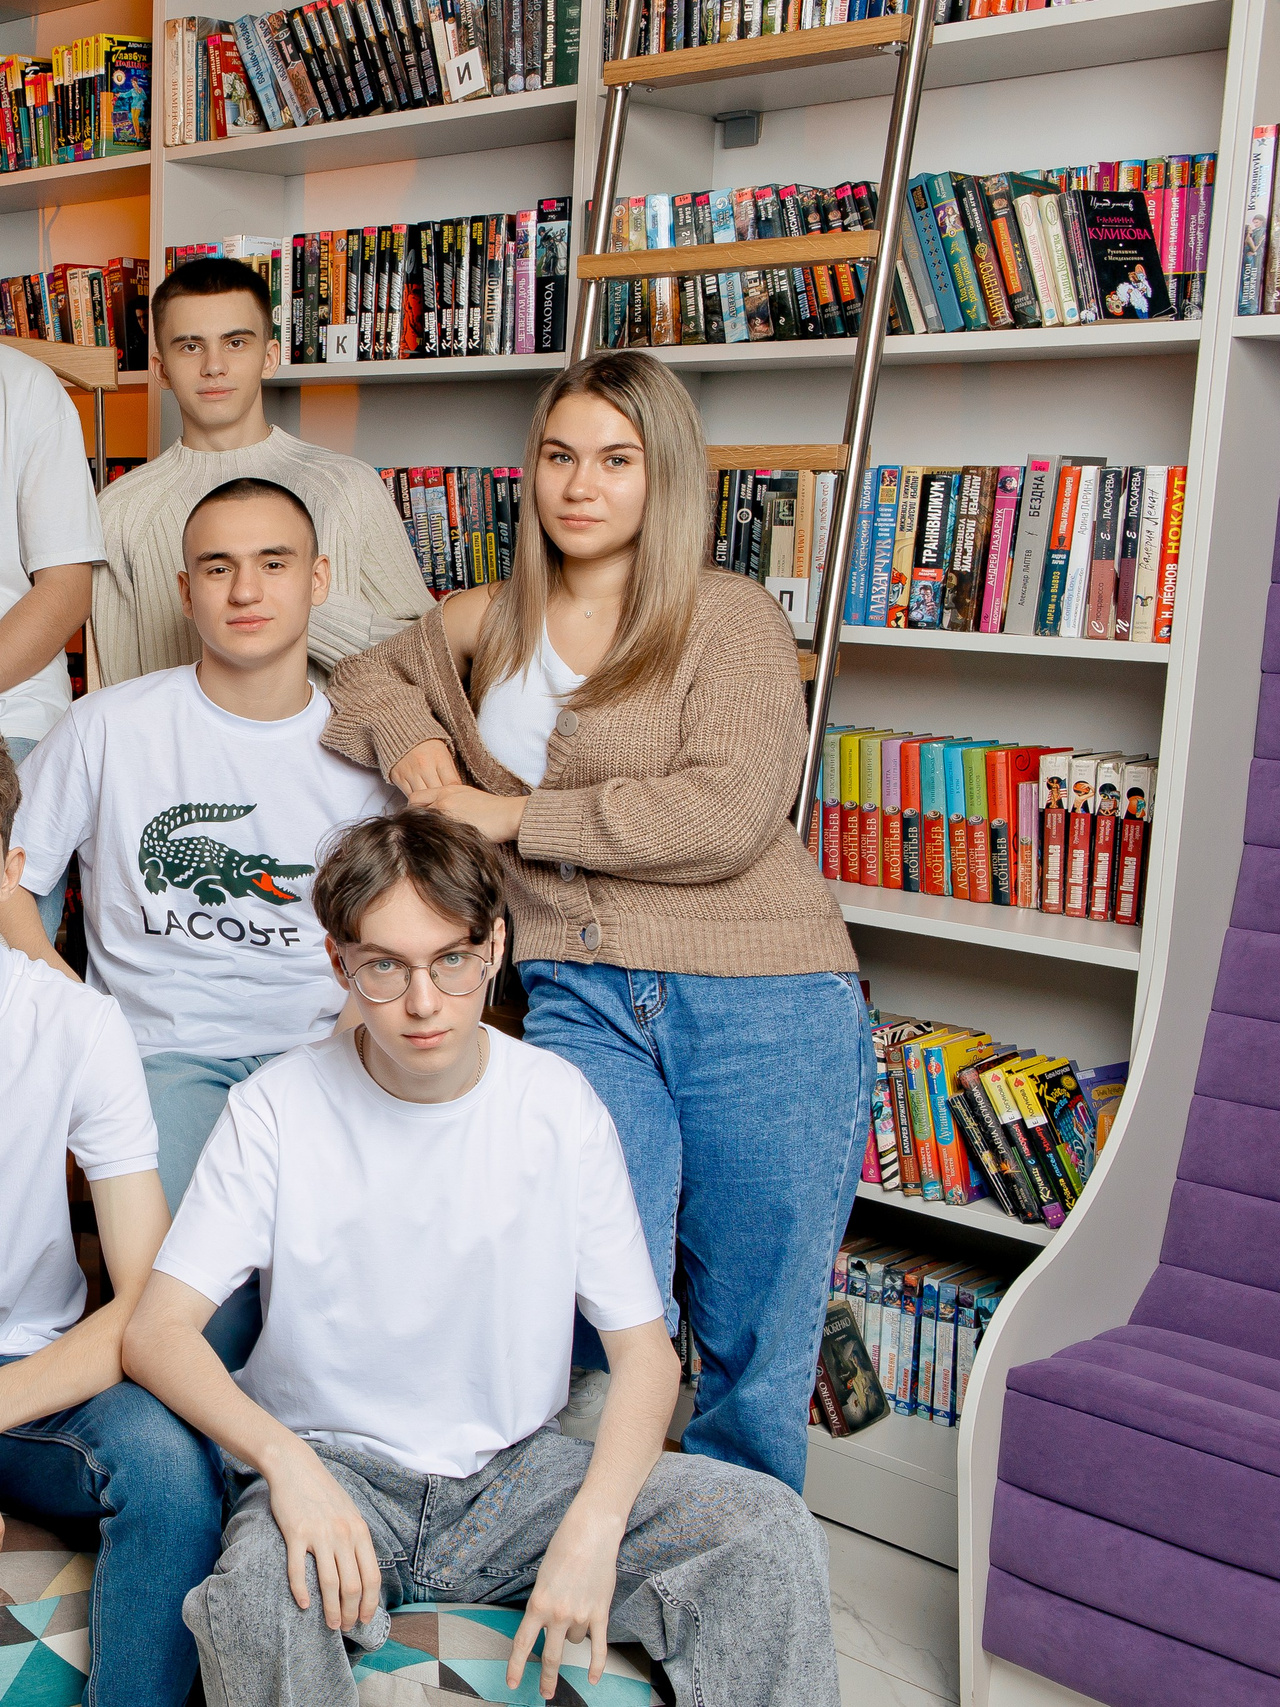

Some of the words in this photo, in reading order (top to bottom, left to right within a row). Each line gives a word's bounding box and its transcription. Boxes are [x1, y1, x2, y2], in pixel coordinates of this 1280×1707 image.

[238, 22, 258, 49] ГНЕЗДО
[544, 24, 555, 59] Черного
[112, 46, 146, 62] Главбух
[249, 50, 266, 85] БОЛЬШОЕ
[456, 61, 472, 86] И
[544, 61, 554, 85] Тайна
[967, 189, 977, 207] АГЕНТ
[1147, 199, 1156, 220] ТЕЛО
[972, 207, 983, 232] ОСОБЫЙ
[1088, 227, 1152, 240] КУЛИКОВА
[1168, 197, 1180, 243] НАМЕРЕНИЯ
[1167, 245, 1177, 269] НАГИЕ
[347, 272, 357, 311] ОБОРОТНИ
[363, 272, 372, 309] ОБОРОТНИ
[423, 268, 434, 308] ОБОРОТНИ
[518, 278, 526, 298] ДОЧЬ
[683, 280, 695, 317] НИЖНИЙ
[726, 279, 733, 290] ВО
[806, 285, 817, 317] АНДРЕЯ
[819, 276, 828, 298] УБИТЬ
[841, 274, 851, 296] УБИТЬ
[978, 261, 1006, 318] АНТИТЕРРОР
[518, 299, 526, 342] ЧЕТВЕРТАЯ
[542, 282, 555, 348] КУКЛОВОД
[727, 291, 737, 318] ДВЕРИ
[336, 335, 347, 354] К
[468, 307, 481, 349] КАЗАНЦЕВ
[961, 474, 971, 515] МИХАИЛ
[970, 475, 981, 515] АНДРЕЙ
[1029, 475, 1045, 517] БЕЗДНА
[1080, 478, 1094, 511] ЛАРИНА
[1102, 472, 1116, 519] ЛАСКАРЕВА
[1128, 471, 1141, 518] ЛАСКАРЕВА
[1143, 488, 1159, 526] Леман
[922, 481, 945, 564] ТРАНКВИЛИУМ
[991, 508, 1003, 551] ЛАЗАРЧУК
[1077, 512, 1089, 535] Арина
[1167, 476, 1186, 554] НОКАУТ
[451, 528, 460, 541] 12
[498, 522, 509, 544] БОЙ
[859, 519, 870, 572] УСПЕНСКИЙ
[953, 518, 965, 571] УСПЕНСКИЙ
[961, 519, 975, 572] ЛАЗАРЧУК
[1138, 529, 1155, 571] Валерия
[454, 541, 463, 581] МАРОСЕЙКА
[871, 538, 892, 614] ЛАЗАРЧУК
[987, 553, 998, 586] АНДРЕЙ
[1023, 549, 1032, 573] ЛАПТЕВ
[1017, 574, 1030, 607] Александр
[1050, 571, 1061, 593] ВЫВОЗ
[1162, 563, 1178, 606] ЛЕОНОВ
[1046, 603, 1056, 624] ГАРЕМ
[1162, 608, 1174, 619] Н.
[831, 813, 839, 871] ЛЕОНТЬЕВ
[850, 816, 858, 874] ЛЕОНТЬЕВ
[869, 818, 877, 877] ЛЕОНТЬЕВ
[892, 821, 901, 880] ЛЕОНТЬЕВ
[909, 827, 919, 880] ЛЕОНТЬЕВ
[933, 826, 943, 886] ЛЕОНТЬЕВ
[956, 829, 968, 890] ЛЕОНТЬЕВ
[976, 831, 987, 892] ЛЕОНТЬЕВ
[999, 838, 1009, 893] ЛЕОНТЬЕВ
[1045, 845, 1060, 879] Леонтьев
[1068, 849, 1085, 884] Леонтьев
[1093, 852, 1110, 887] Леонтьев
[1119, 856, 1137, 892] Леонтьев
[1045, 881, 1060, 904] Антон
[1067, 886, 1083, 908] Антон
[1091, 889, 1107, 912] Антон
[1117, 893, 1133, 917] Антон
[139, 905, 302, 947] LACOSE
[895, 1079, 903, 1100] РЕДУТ
[971, 1086, 995, 1128] ЛОГУНОВА
[996, 1084, 1012, 1112] Логунова
[1019, 1088, 1038, 1118] Логунова
[898, 1100, 907, 1126] ДЕРЖИТ
[935, 1095, 950, 1141] Луганцева
[901, 1126, 910, 1154] БАТАРЕЯ
[992, 1129, 1006, 1154] ЕЛЕНА
[1033, 1167, 1053, 1202] Кукиш
[886, 1352, 896, 1390] ЛУКЬЯНЕНКО
[901, 1368, 909, 1400] ЛУКЬЯНЕНКО
[923, 1361, 931, 1402] ЛУКЬЯНЕНКО
[942, 1368, 950, 1407] ЛУКЬЯНЕНКО
[818, 1381, 840, 1425] ЛЮБЕНКО
